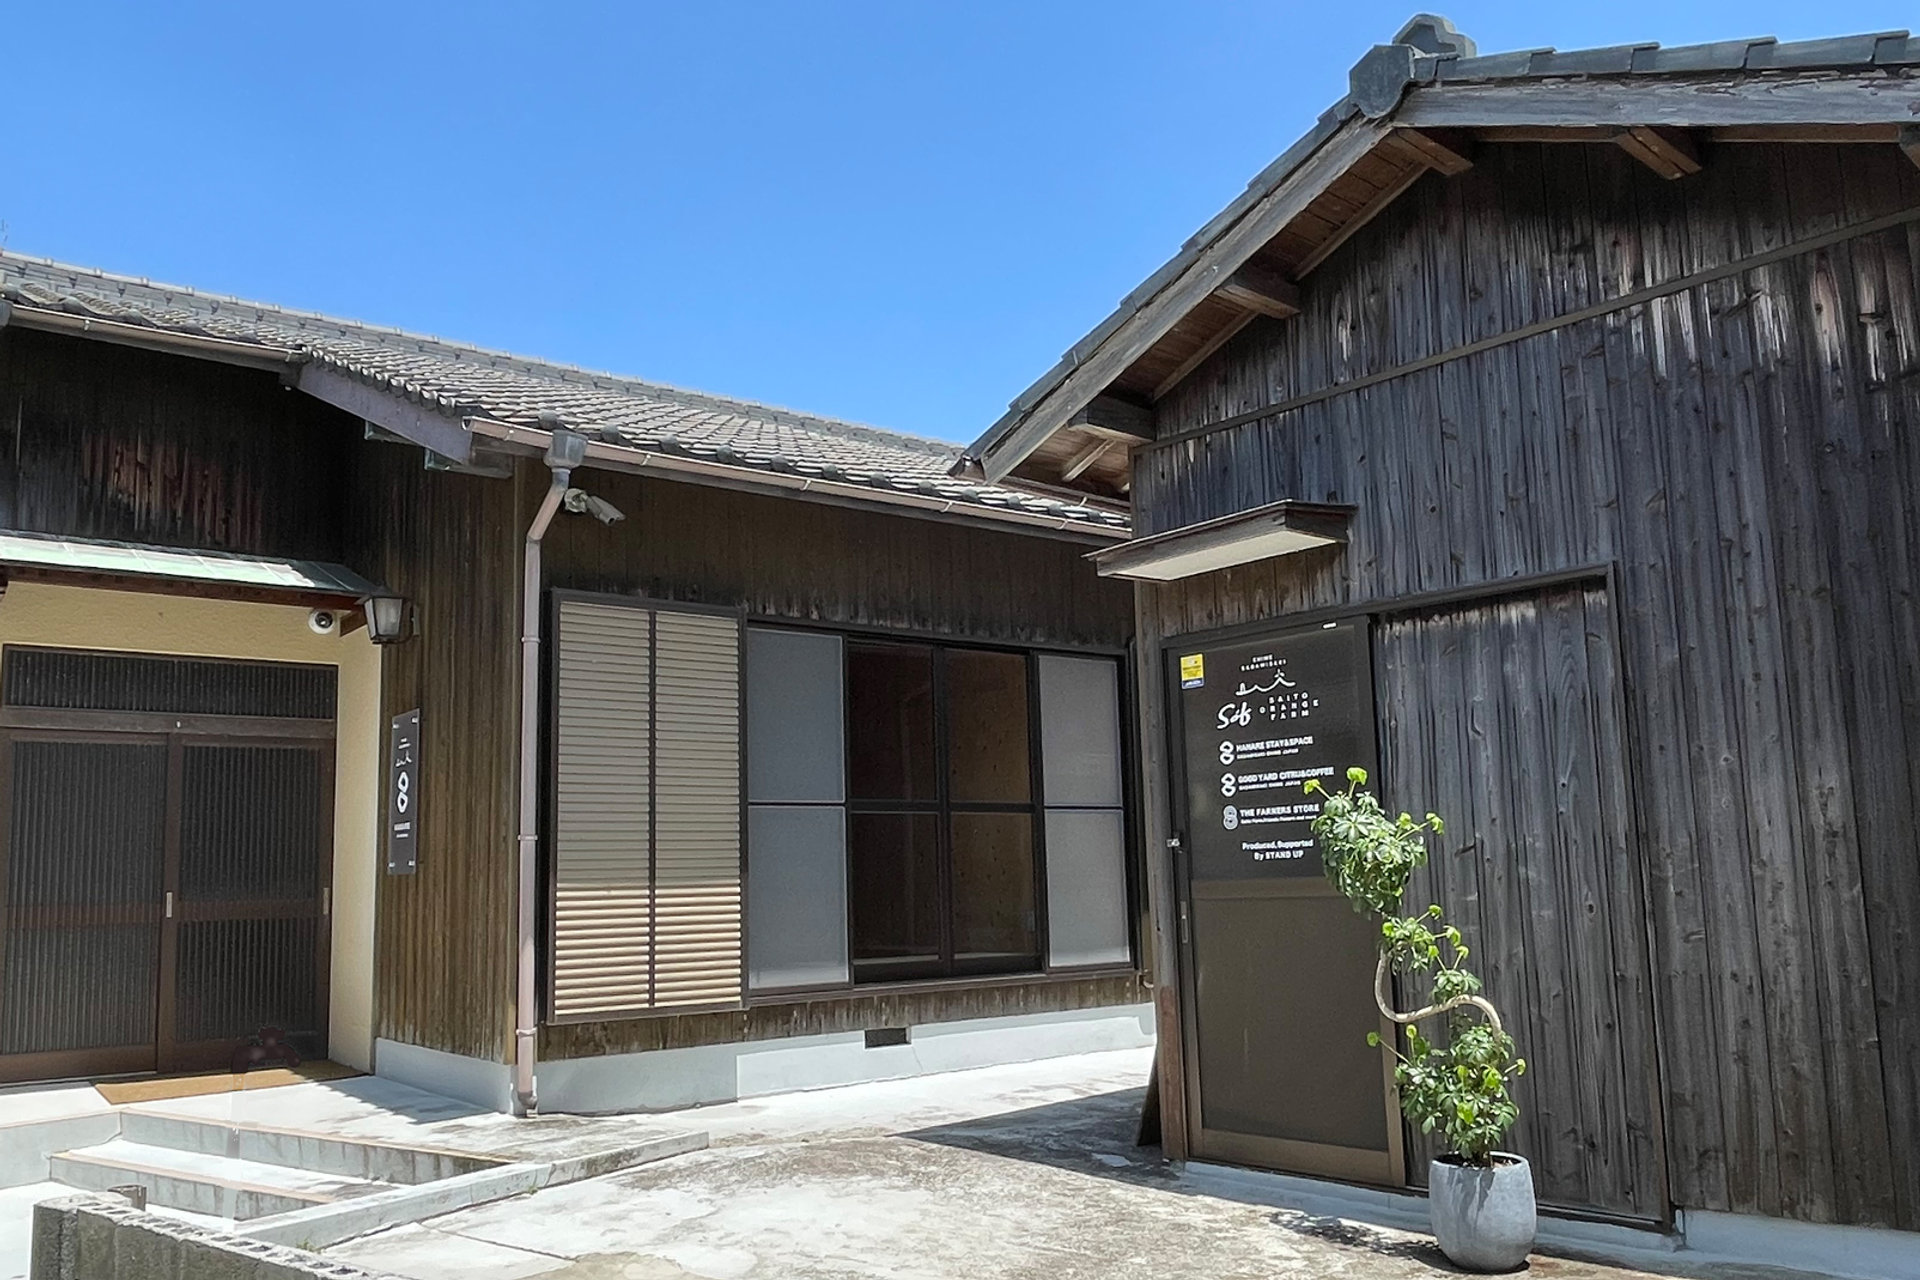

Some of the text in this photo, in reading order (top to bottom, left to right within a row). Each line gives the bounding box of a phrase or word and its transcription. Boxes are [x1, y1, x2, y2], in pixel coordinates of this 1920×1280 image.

[1268, 692, 1309, 704] SAITO
[1259, 699, 1319, 714] ORANGE
[1270, 710, 1309, 721] FARM
[1237, 775, 1258, 784] GOOD
[1258, 772, 1278, 781] YARD
[1239, 809, 1255, 818] THE
[1292, 803, 1320, 813] STORE
[1254, 850, 1304, 861] By STAND UP
